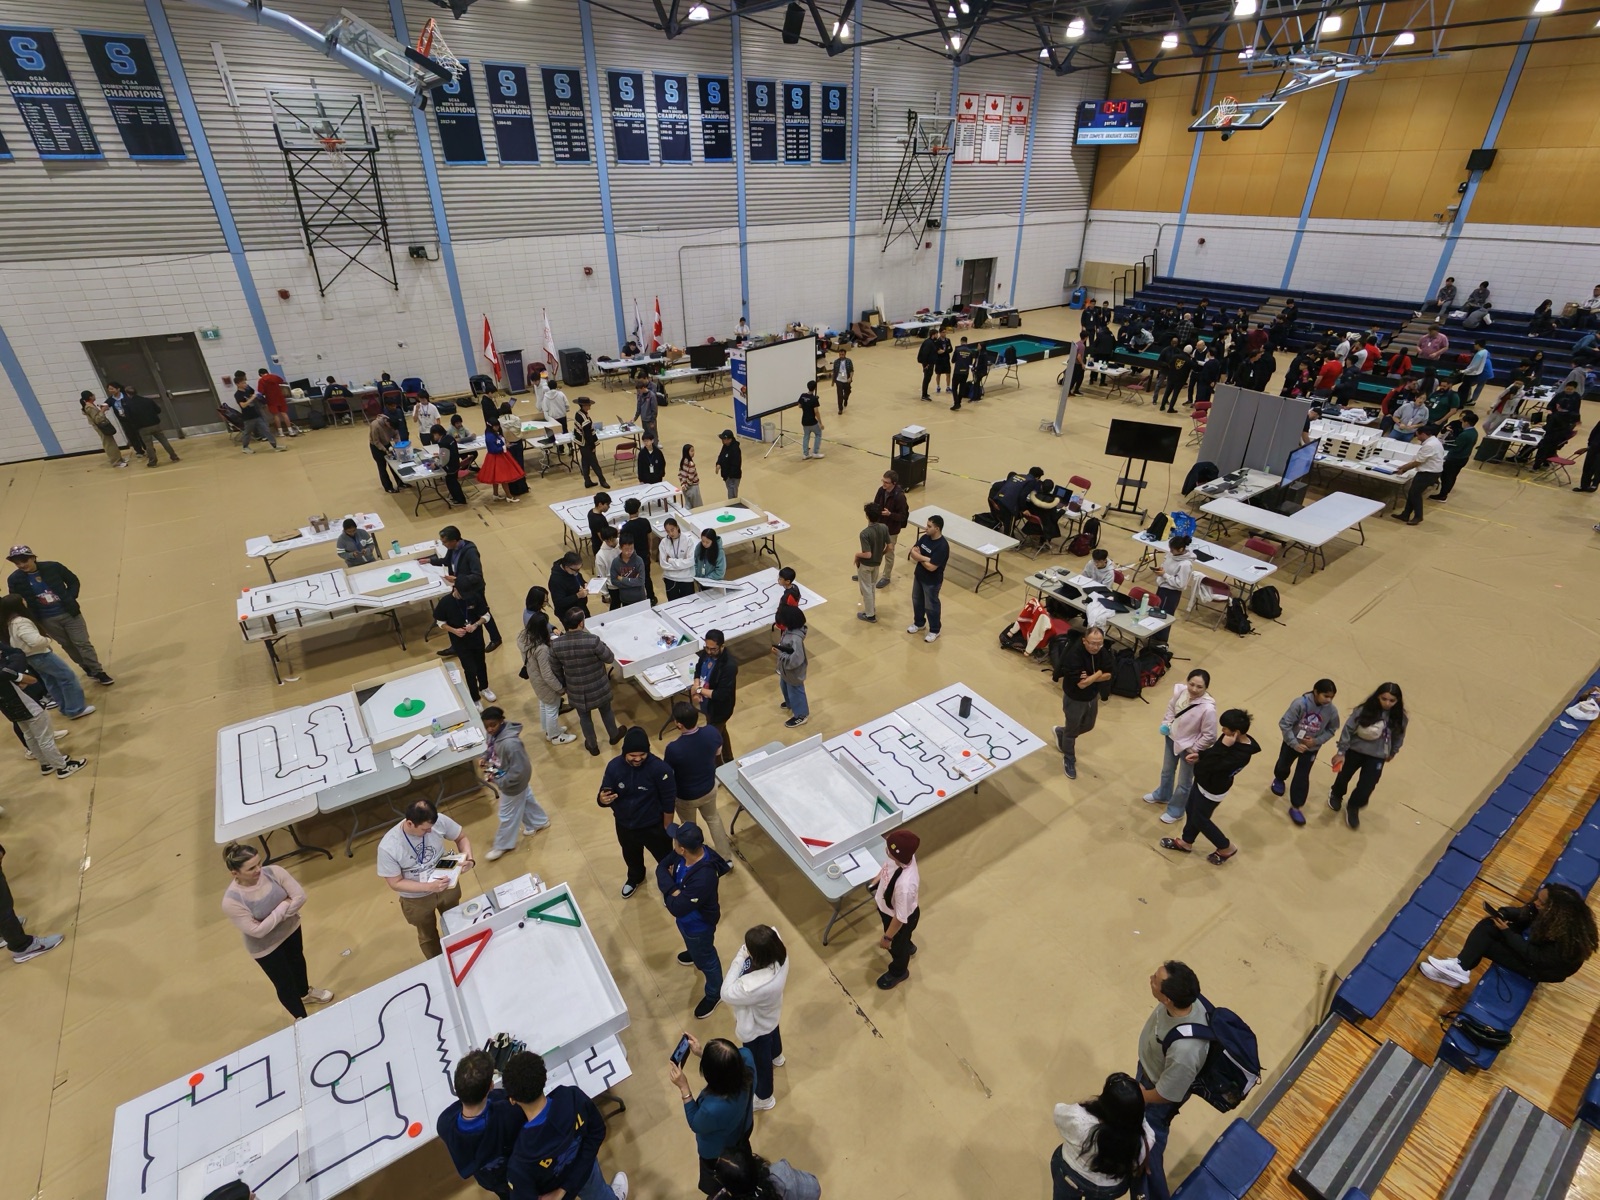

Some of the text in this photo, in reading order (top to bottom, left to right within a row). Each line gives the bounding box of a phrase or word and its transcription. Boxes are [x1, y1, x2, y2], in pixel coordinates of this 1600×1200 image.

[9, 36, 46, 70] S
[104, 42, 137, 75] S
[10, 86, 76, 95] CHAMPIONS
[104, 90, 164, 98] CHAMPIONS
[498, 70, 518, 96] S
[554, 74, 571, 98] S
[619, 77, 634, 100] S
[664, 80, 679, 103] S
[708, 82, 720, 104] S
[756, 85, 768, 107] S
[792, 88, 803, 109] S
[829, 90, 840, 110] S
